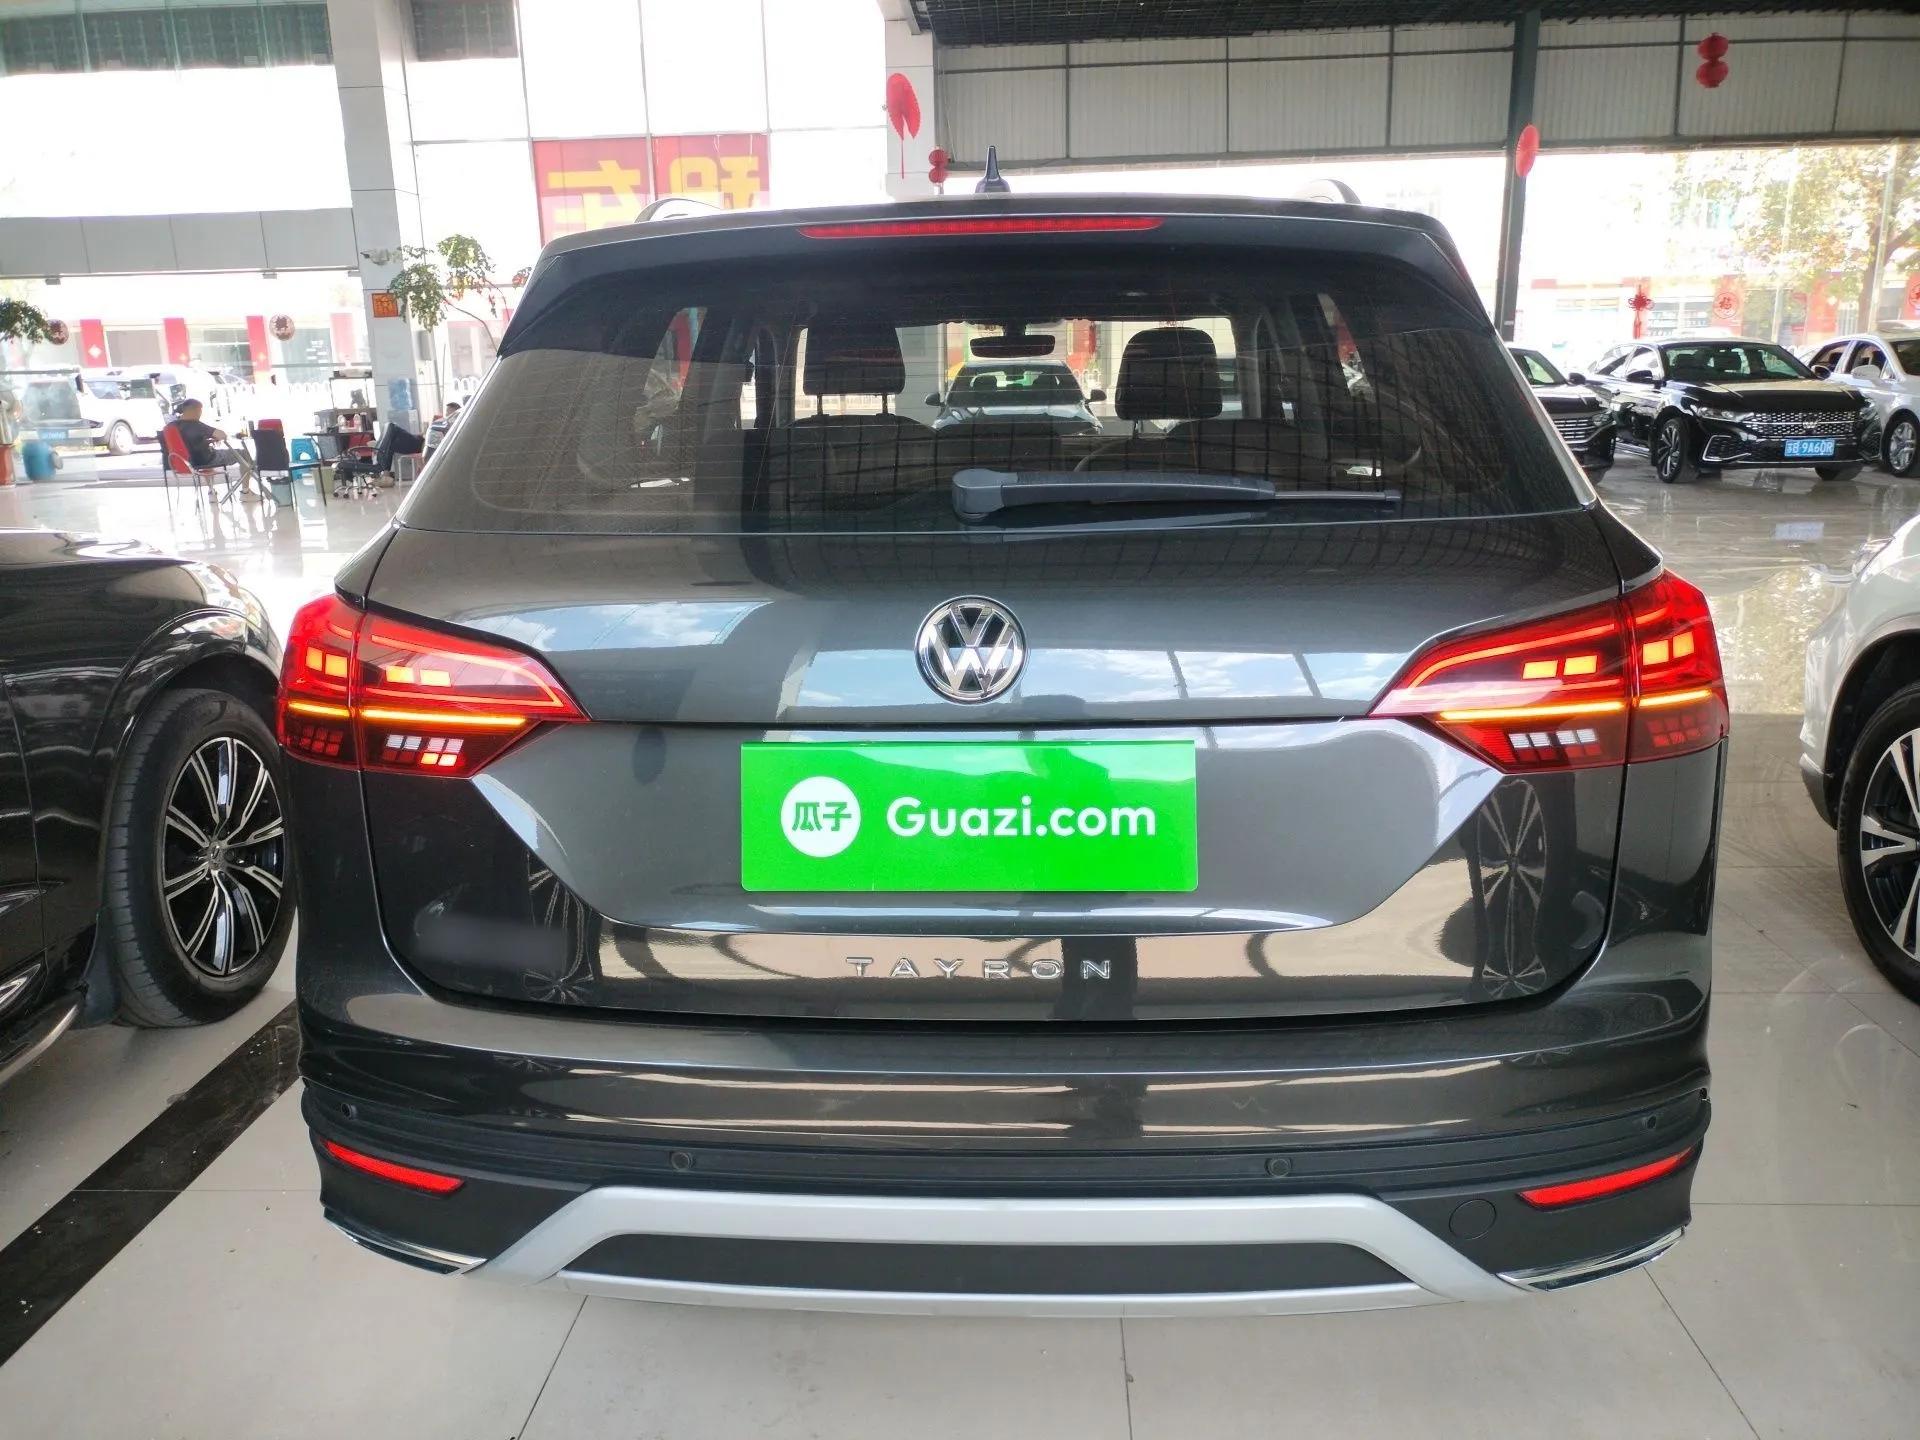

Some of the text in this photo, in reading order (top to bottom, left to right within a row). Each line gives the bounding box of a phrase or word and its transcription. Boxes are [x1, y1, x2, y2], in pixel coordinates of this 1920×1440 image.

[791, 801, 852, 832] 瓜子
[886, 795, 1157, 837] Guazi.com
[846, 956, 1112, 980] TAYRON
